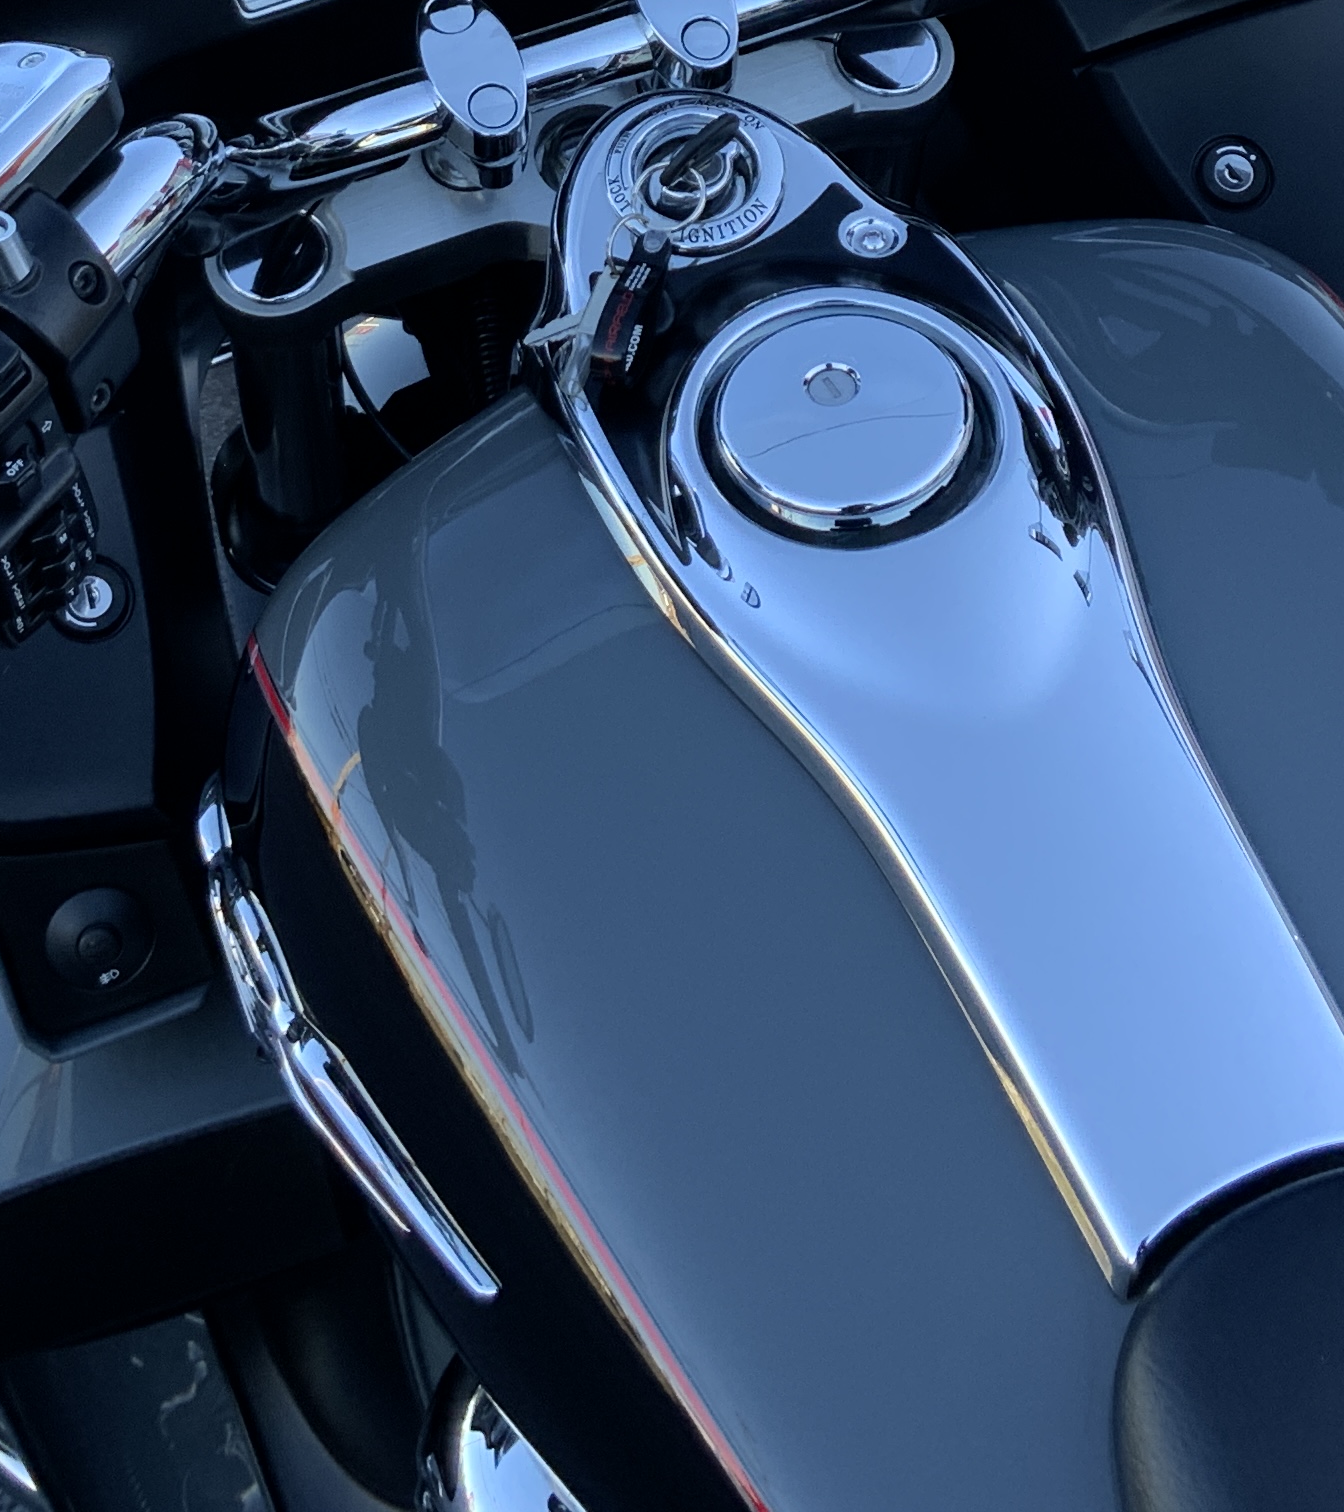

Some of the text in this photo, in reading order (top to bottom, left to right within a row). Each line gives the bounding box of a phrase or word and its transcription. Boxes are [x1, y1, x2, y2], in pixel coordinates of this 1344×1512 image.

[743, 114, 765, 131] ON
[607, 174, 633, 214] LOCK
[678, 197, 769, 244] IGNITION
[6, 458, 24, 476] OFF
